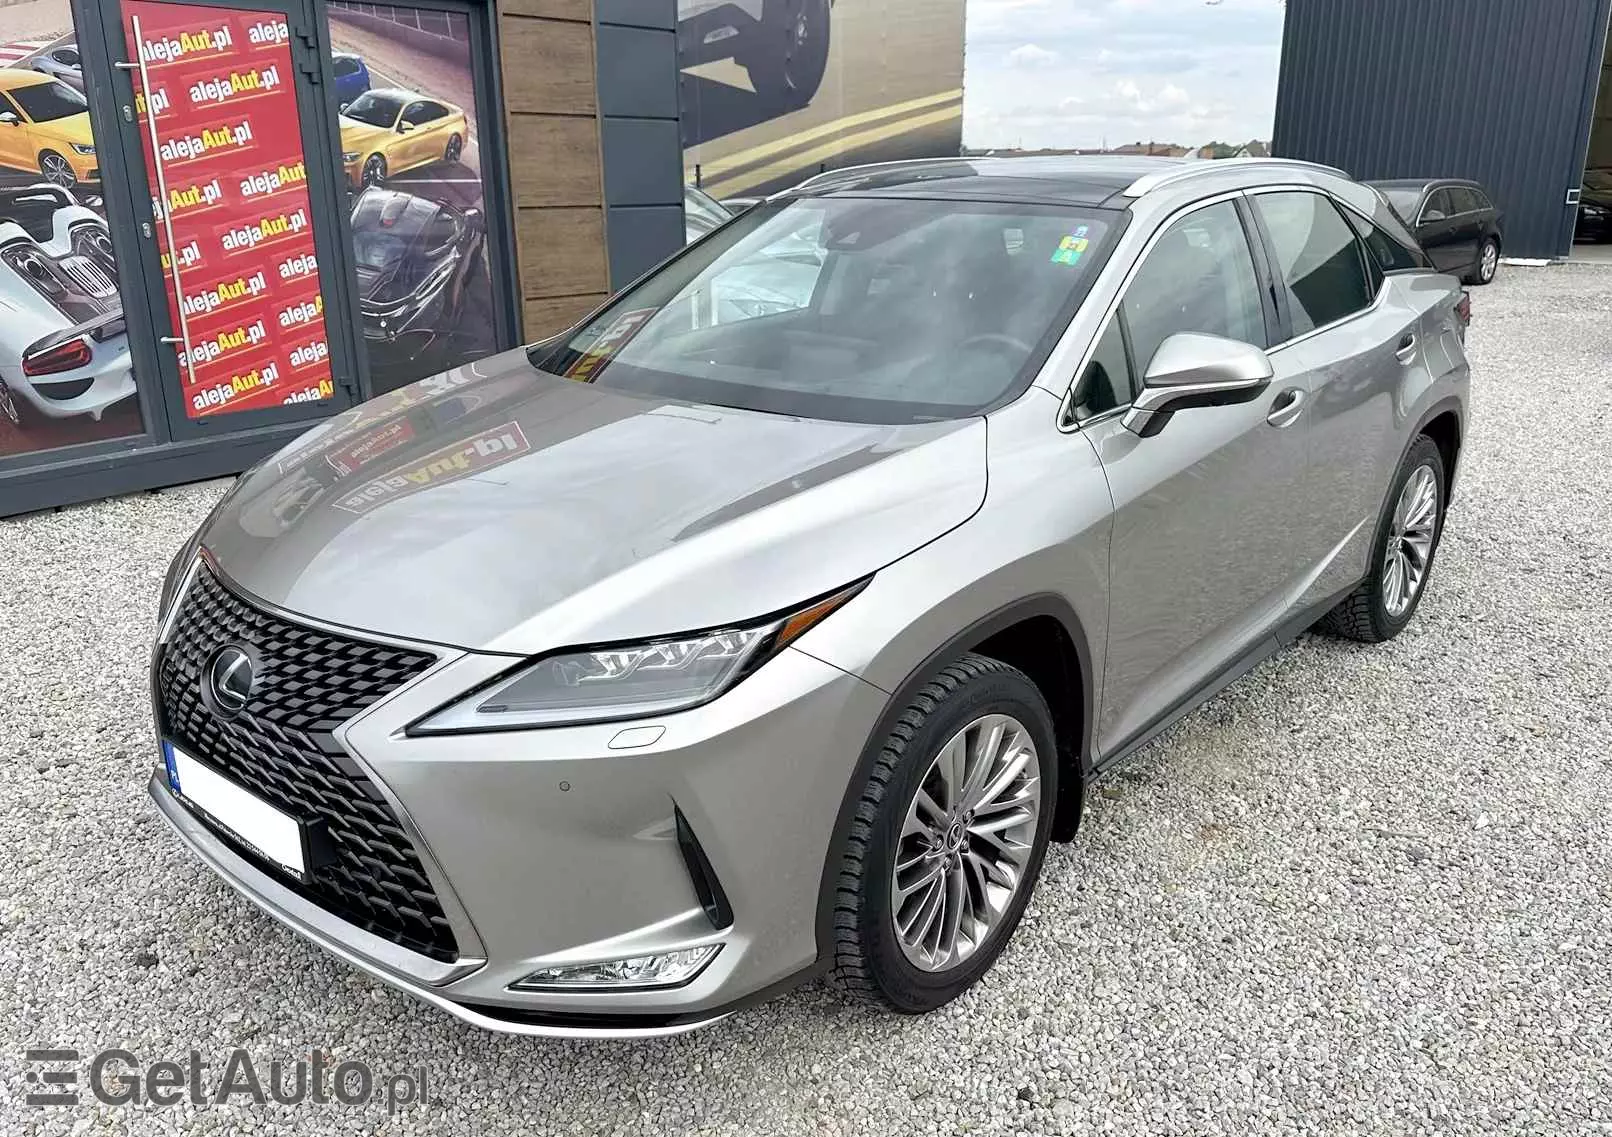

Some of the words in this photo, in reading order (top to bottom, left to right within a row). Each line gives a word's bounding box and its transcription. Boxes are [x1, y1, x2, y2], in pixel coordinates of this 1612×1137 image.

[249, 20, 288, 44] aleja
[189, 65, 280, 103] alejaAut.pl
[160, 121, 252, 161] alejaAut.pl
[240, 162, 307, 197] alejaAut
[222, 208, 307, 251] alejaAut.pl
[279, 254, 318, 278] aleja
[192, 362, 279, 410] alejaAut.pl
